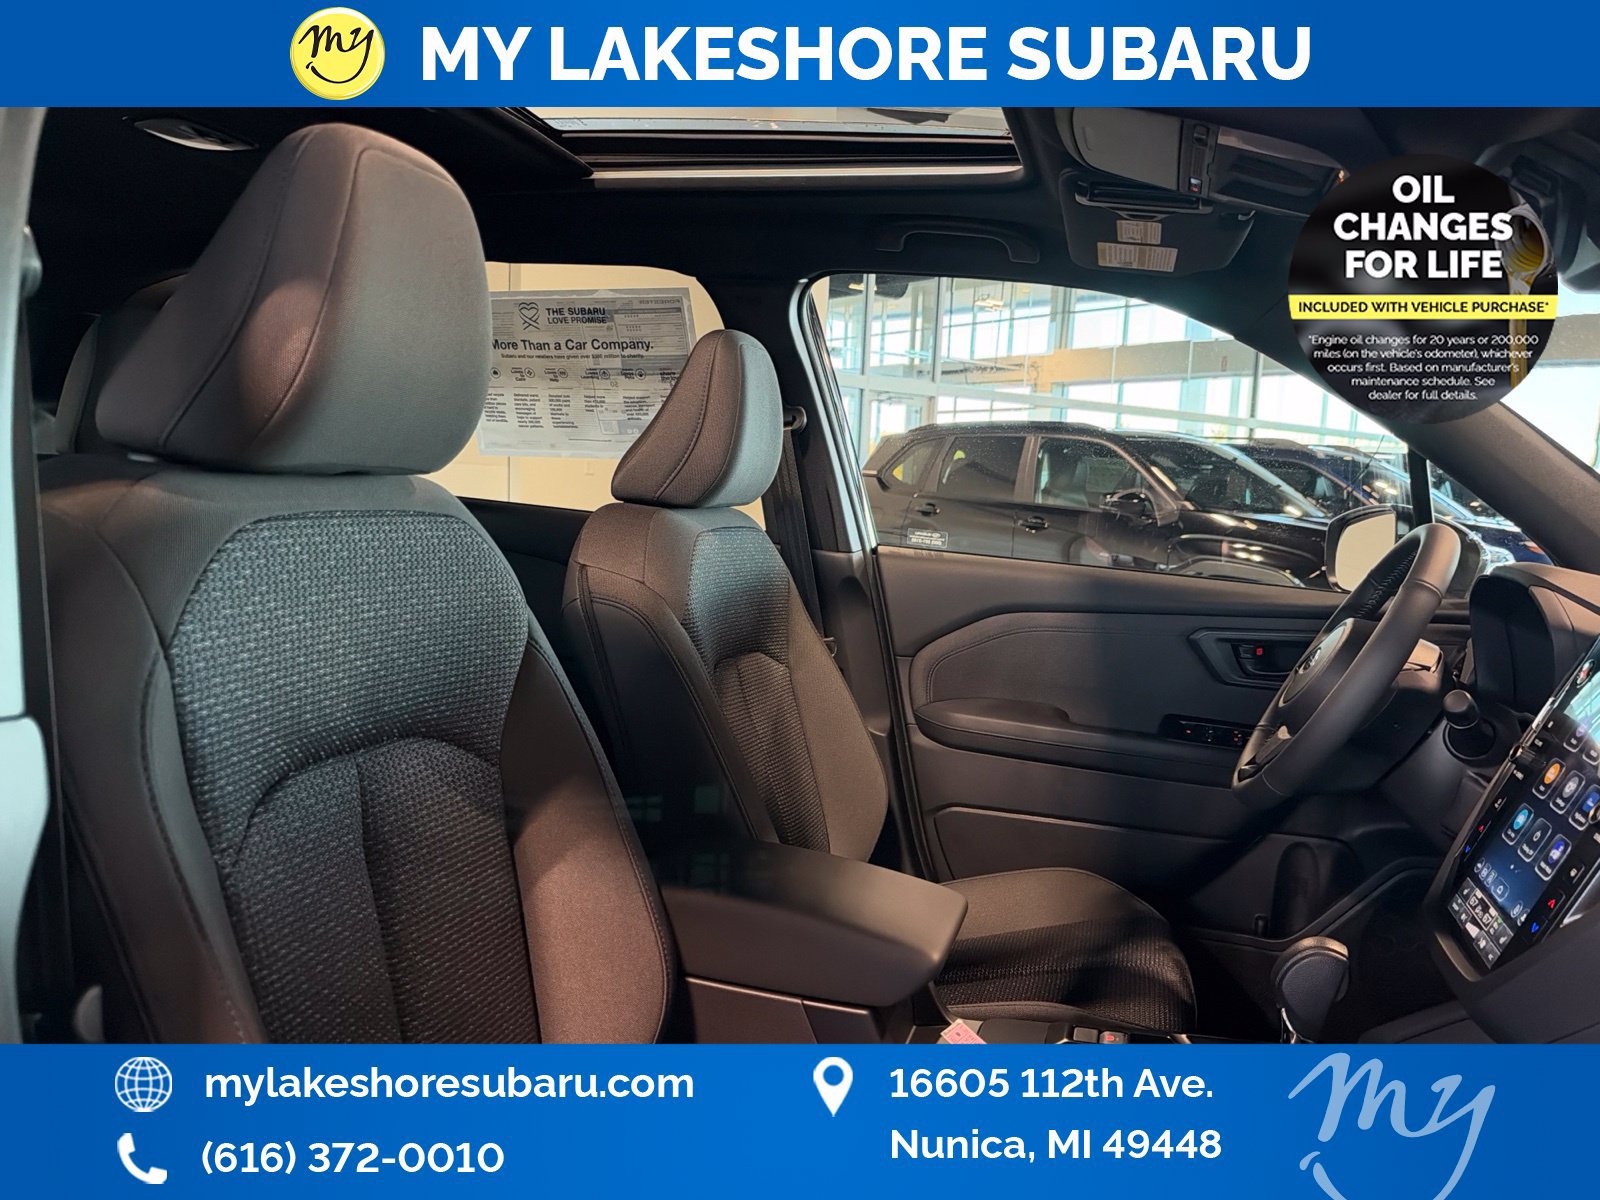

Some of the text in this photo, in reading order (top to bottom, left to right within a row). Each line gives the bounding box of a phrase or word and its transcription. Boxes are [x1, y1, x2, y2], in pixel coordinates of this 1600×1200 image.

[545, 307, 606, 316] THE SUBARU
[547, 316, 607, 324] LOVE PROMISE
[520, 339, 551, 351] Than
[554, 341, 562, 351] a
[565, 338, 588, 351] Car
[591, 338, 654, 352] Company.
